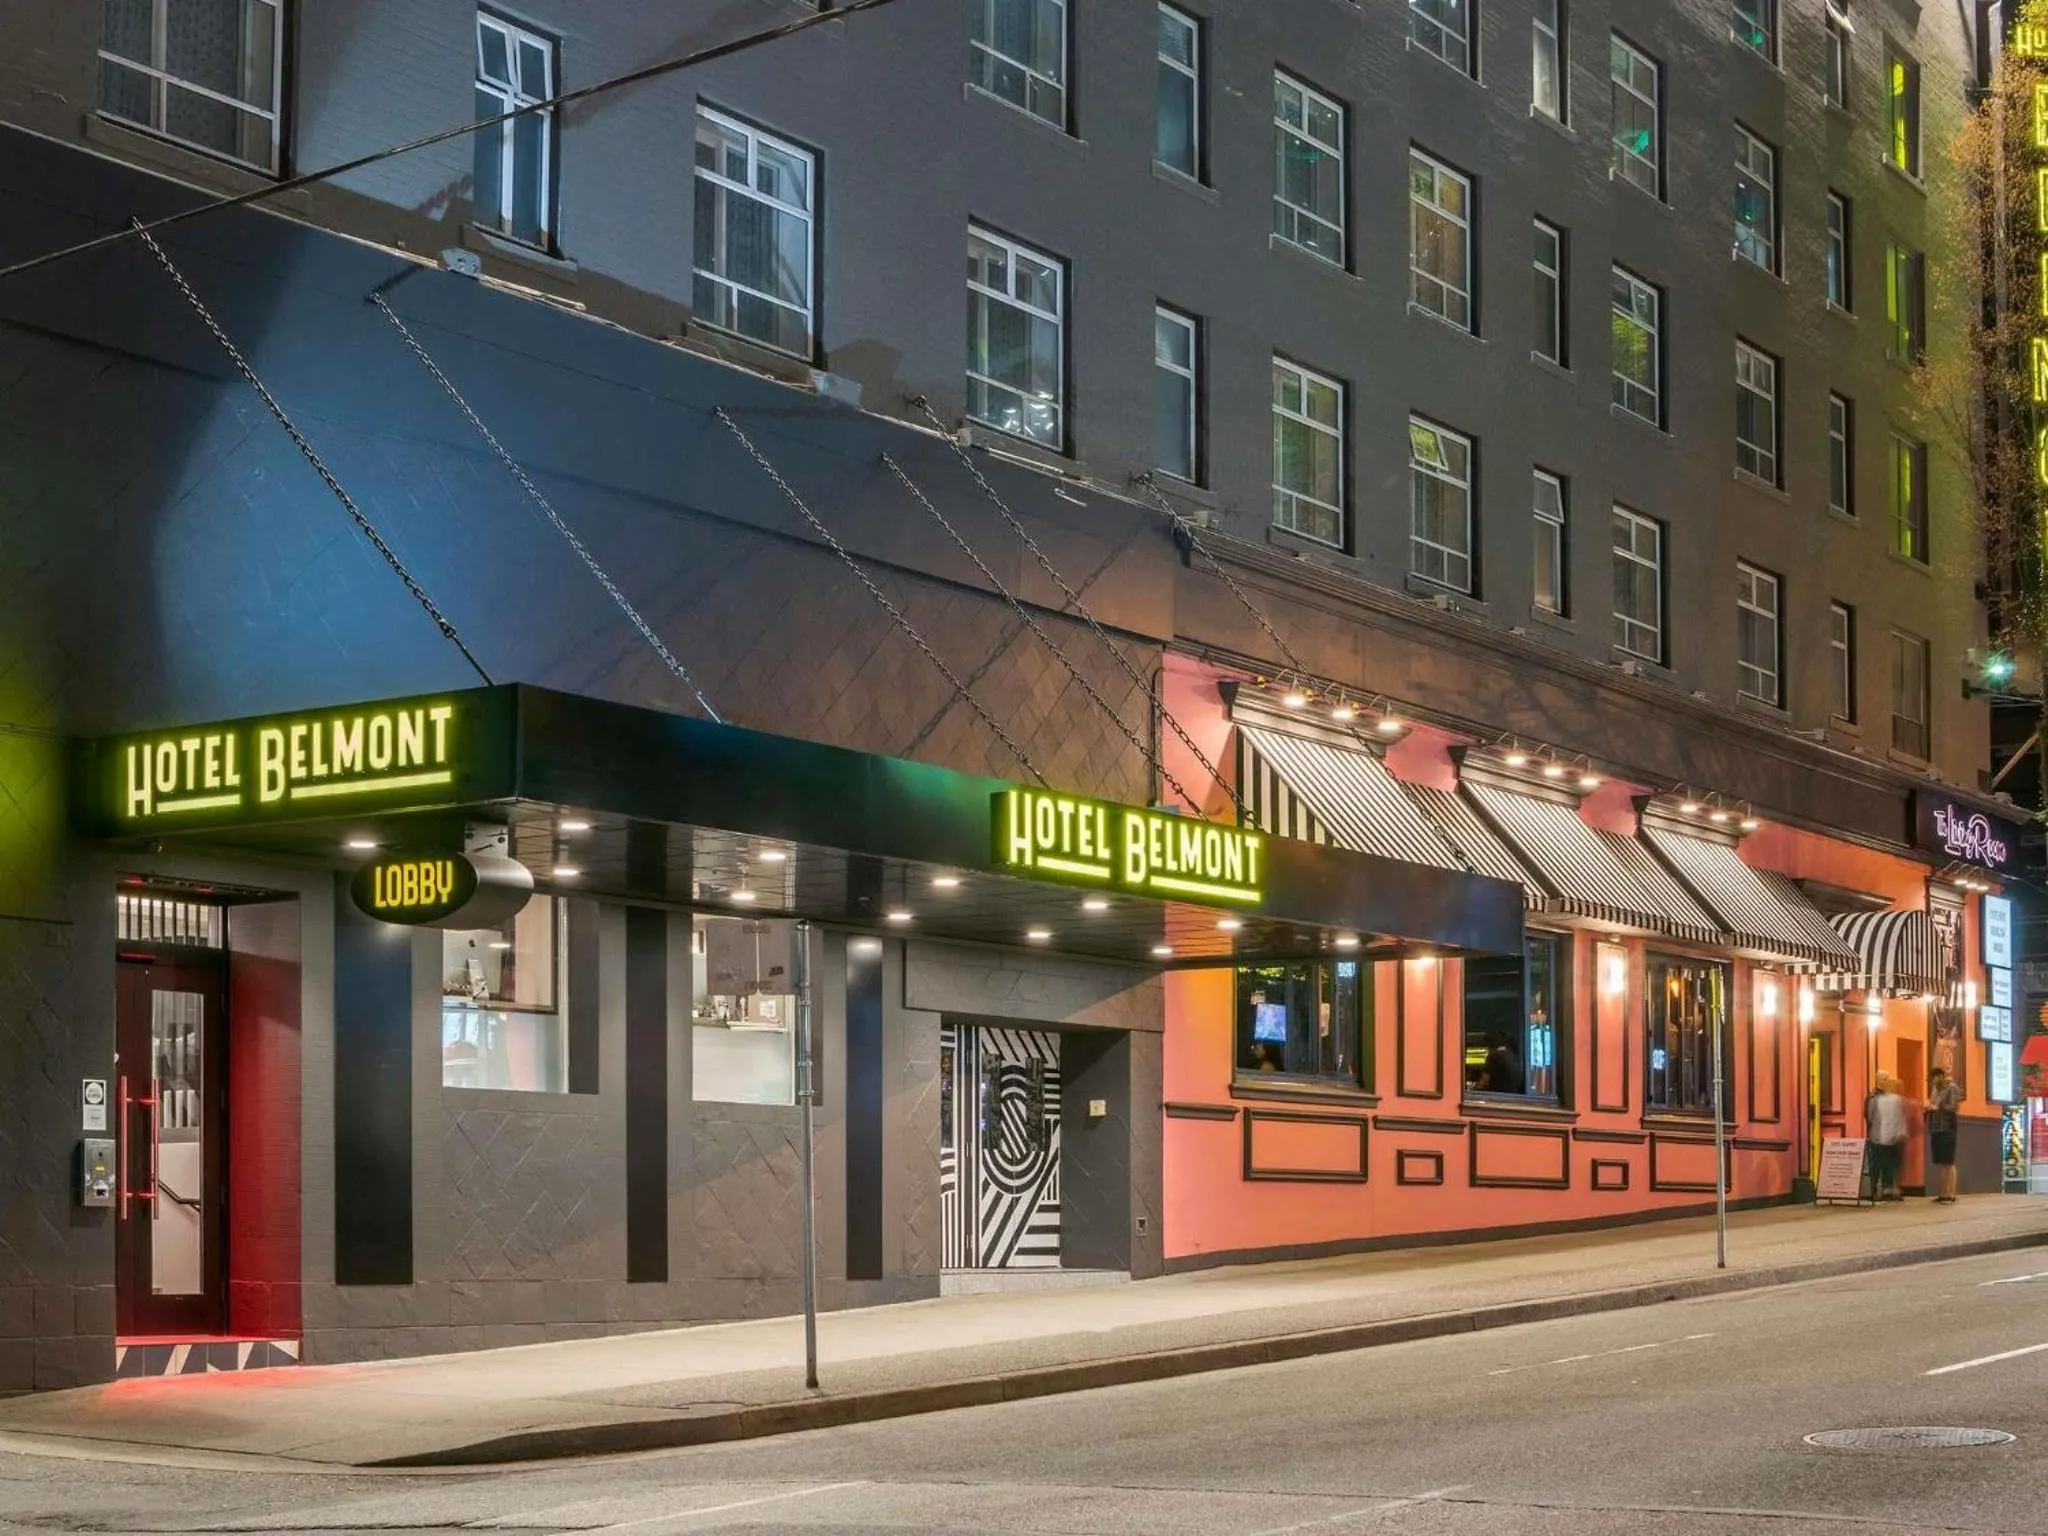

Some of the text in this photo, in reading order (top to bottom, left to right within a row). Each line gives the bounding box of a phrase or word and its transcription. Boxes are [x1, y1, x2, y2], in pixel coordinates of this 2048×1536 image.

[127, 705, 452, 817] HOTEL BELMONT
[375, 860, 453, 909] LOBBY
[1008, 790, 1260, 885] HOTEL BELMONT
